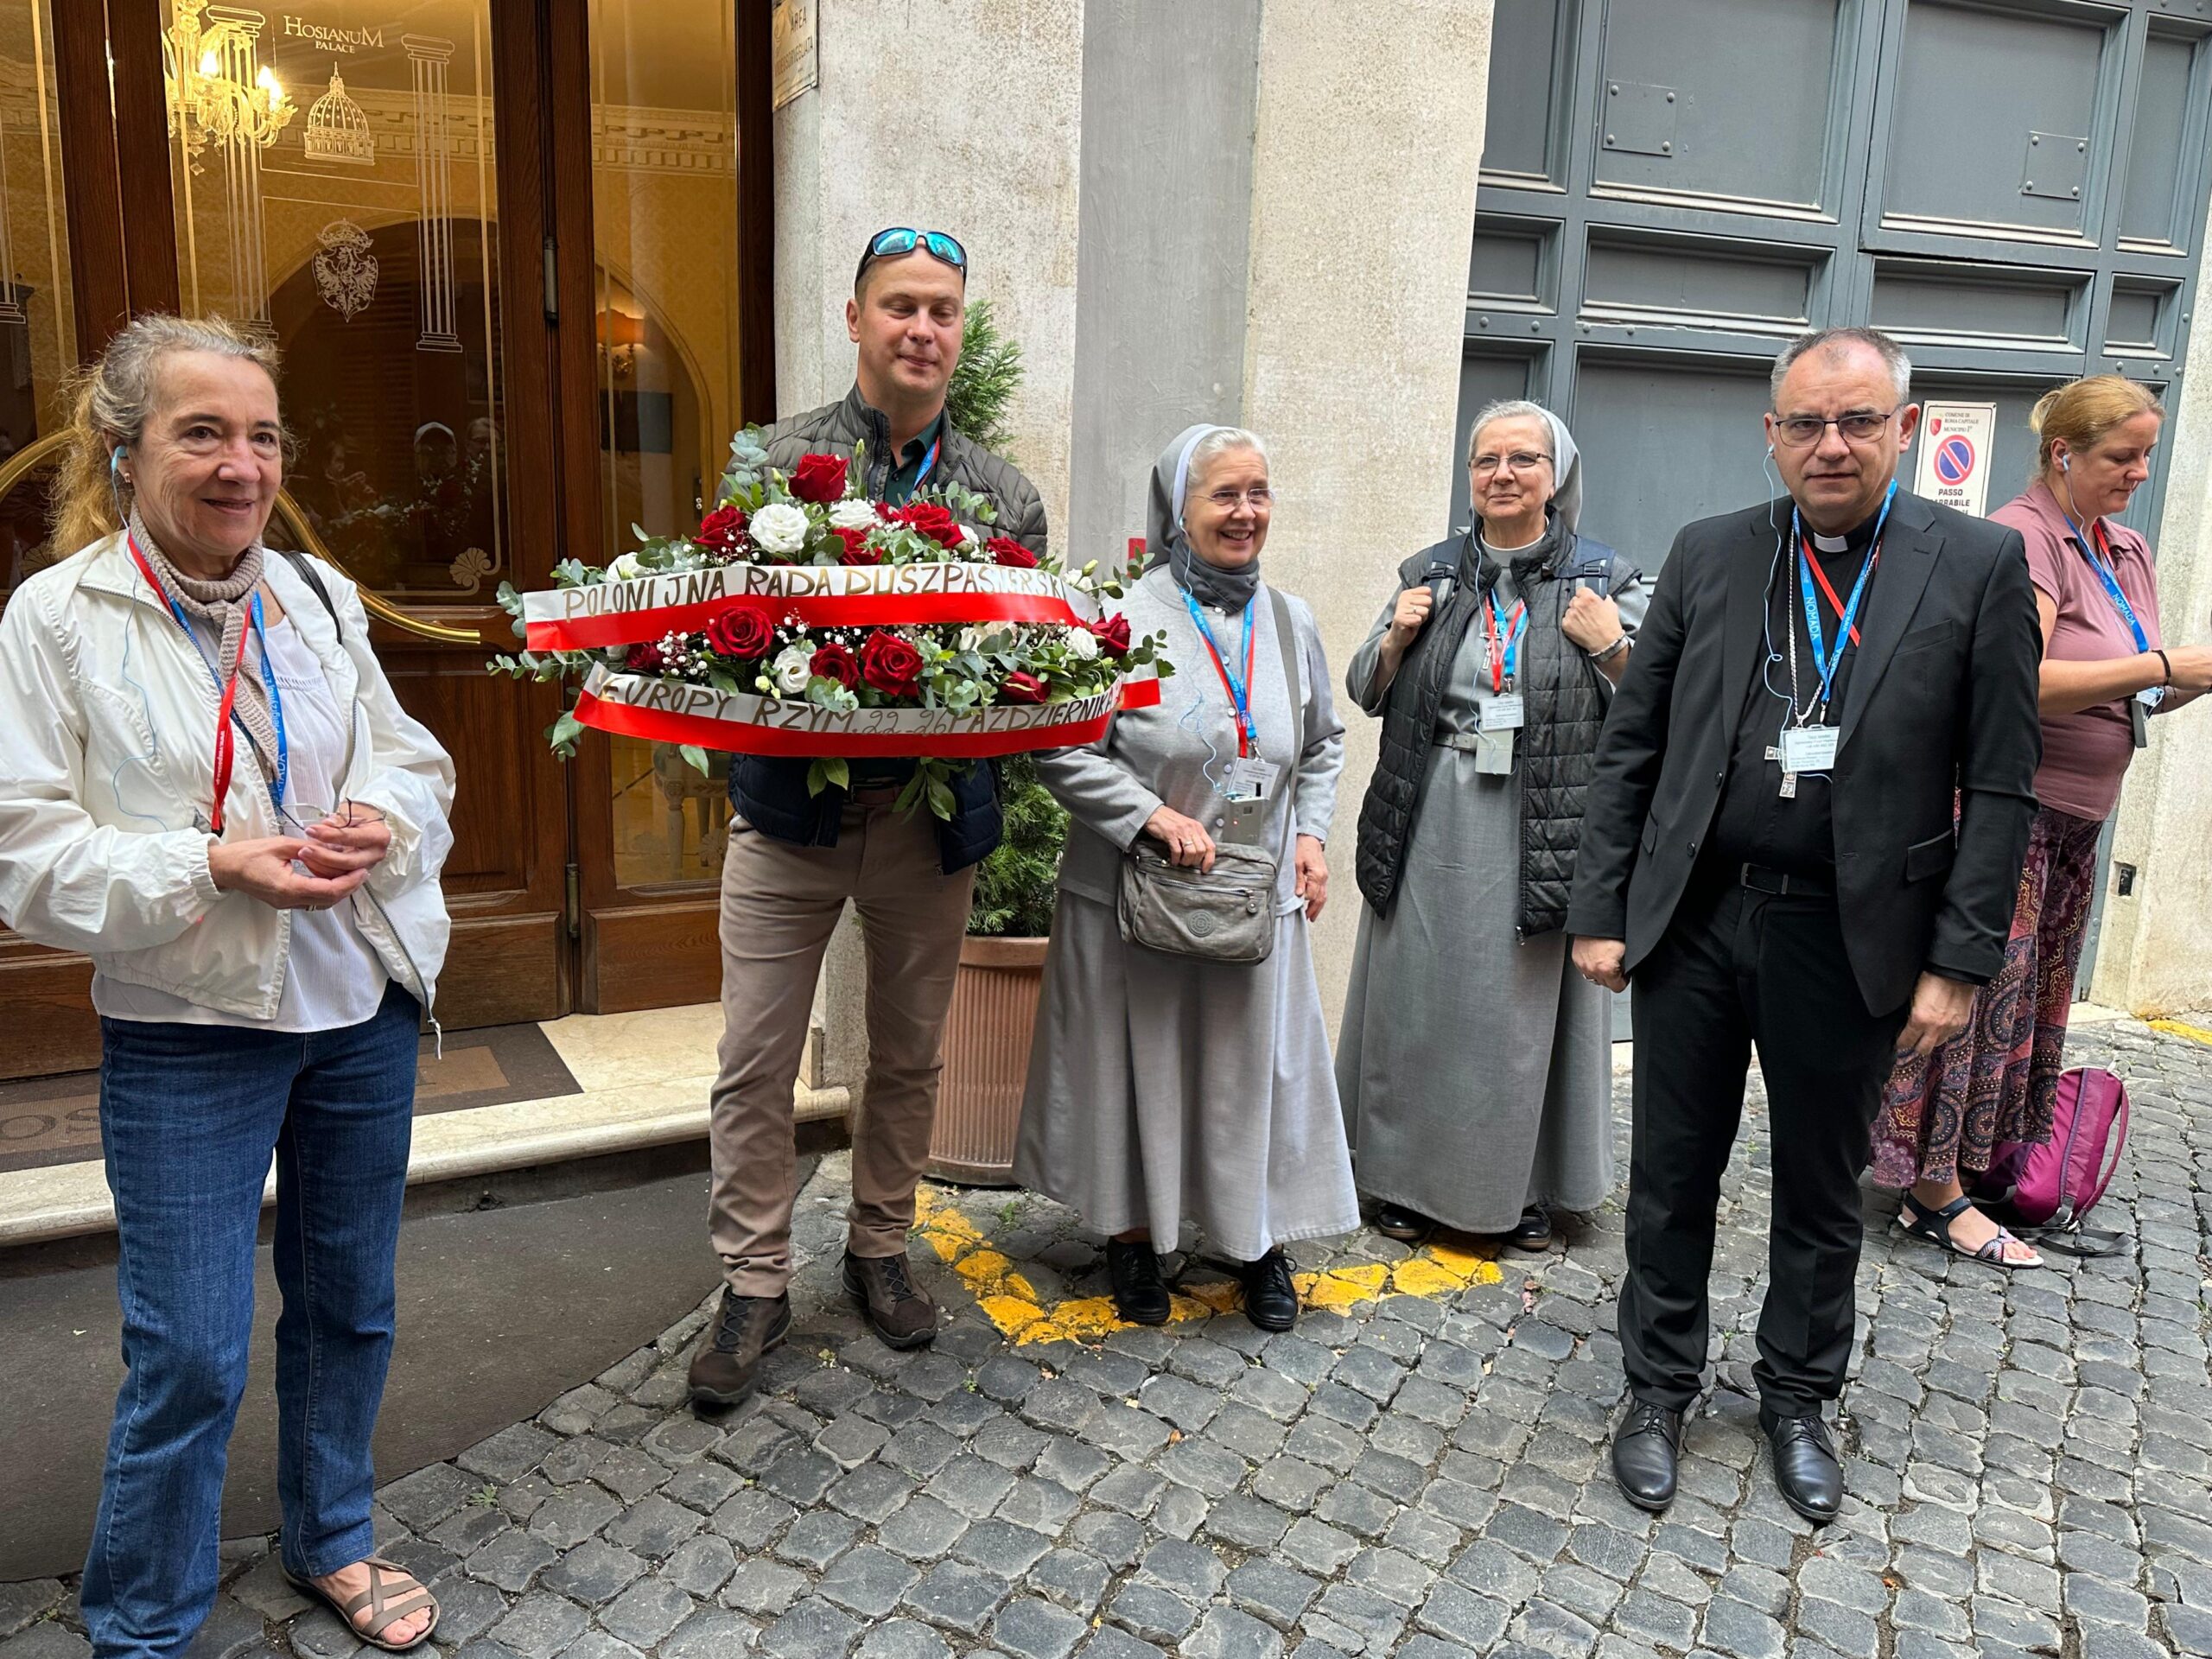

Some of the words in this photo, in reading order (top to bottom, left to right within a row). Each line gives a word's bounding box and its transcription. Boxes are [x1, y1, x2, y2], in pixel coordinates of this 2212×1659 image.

[315, 40, 356, 54] PALACE
[745, 566, 832, 597] RADA
[1804, 596, 1821, 641] NOMADA
[2112, 593, 2137, 626] NOMADA
